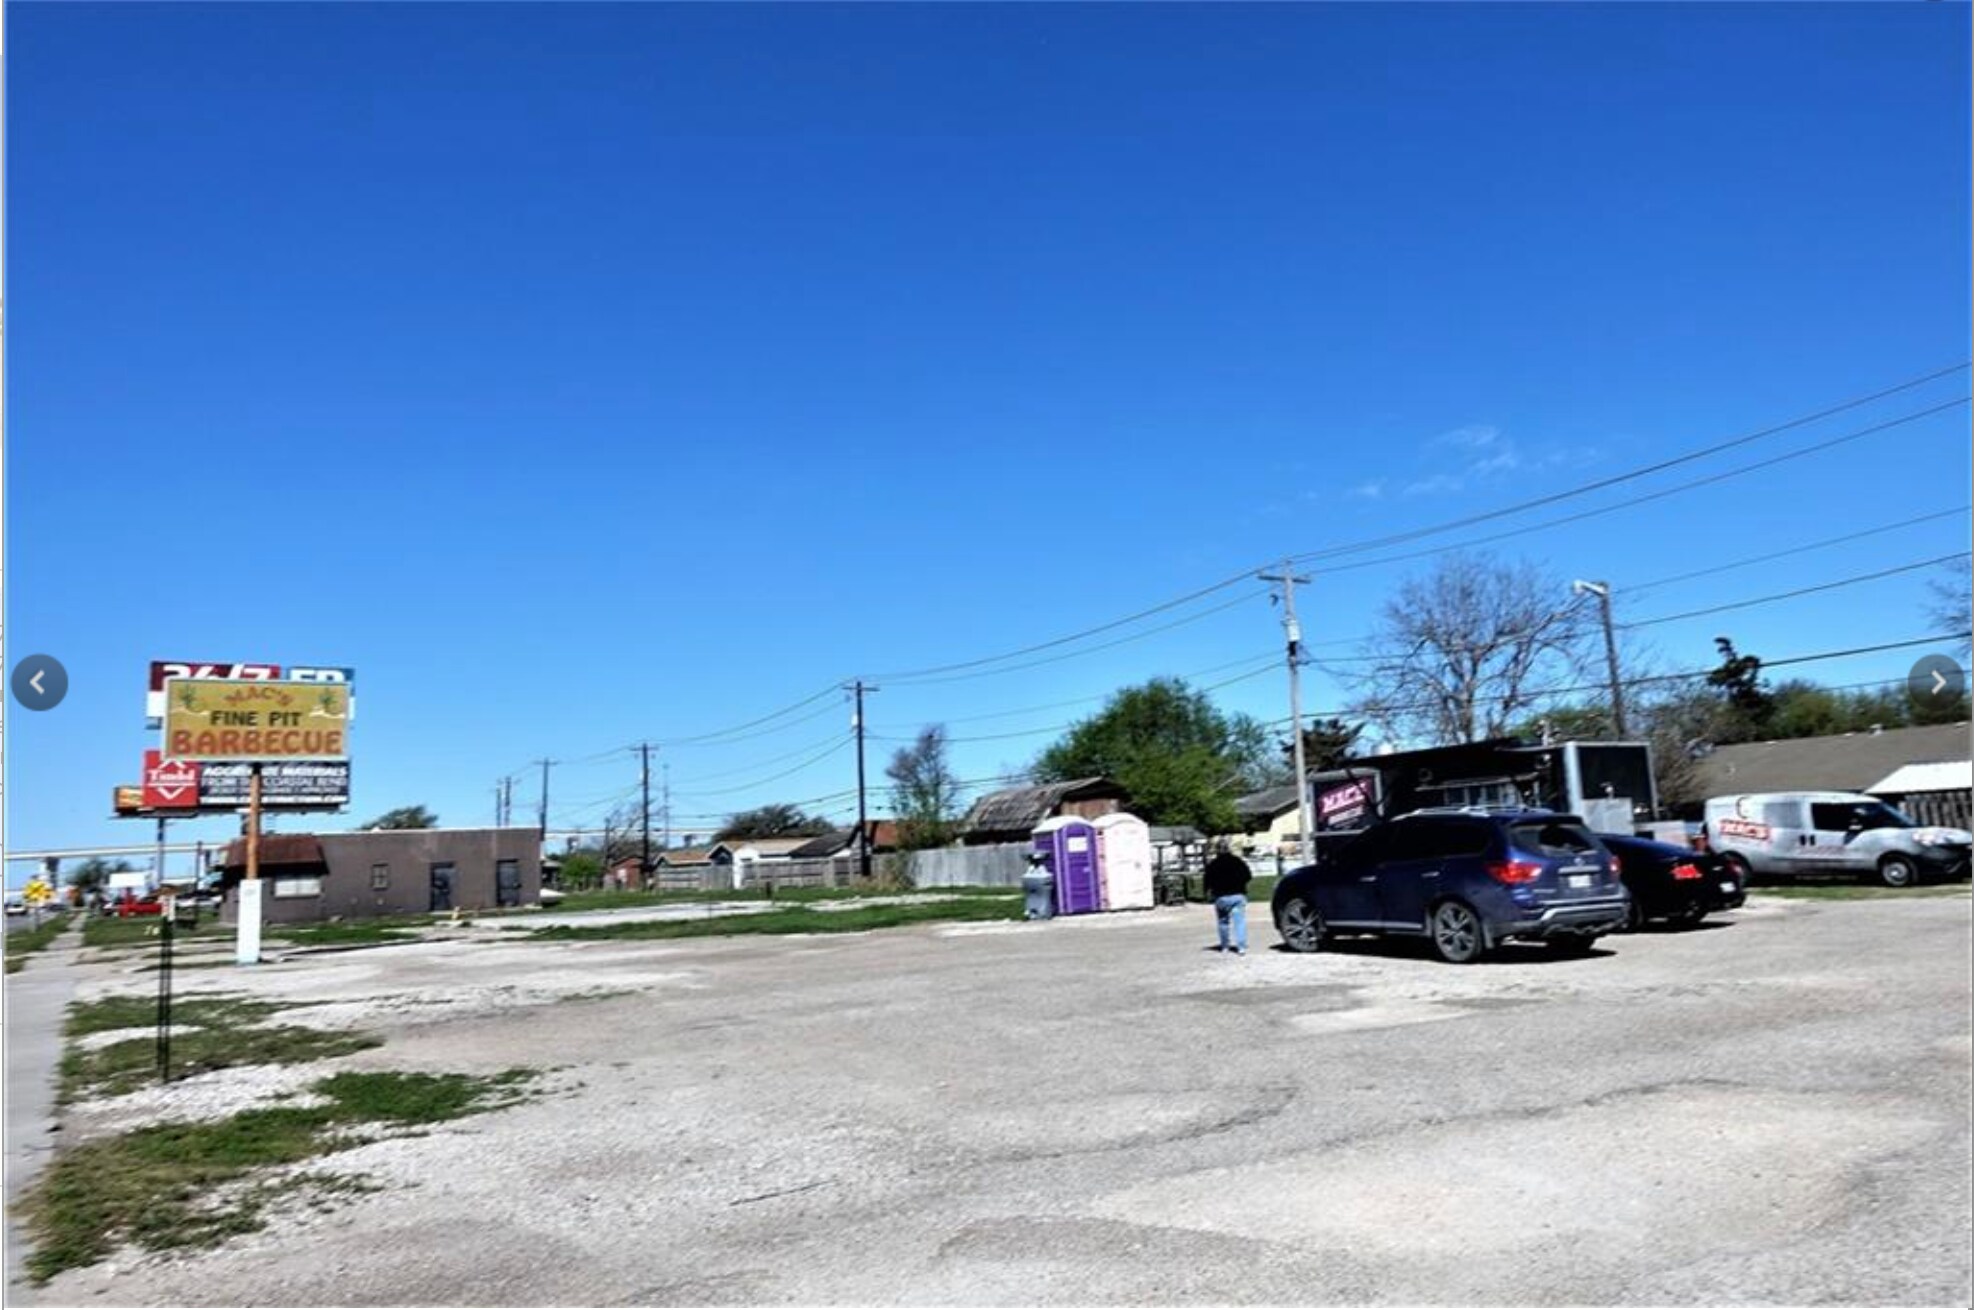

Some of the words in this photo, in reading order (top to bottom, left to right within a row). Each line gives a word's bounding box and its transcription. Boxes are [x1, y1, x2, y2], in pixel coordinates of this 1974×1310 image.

[211, 711, 257, 726] FINE
[269, 711, 302, 726] PIT
[172, 730, 342, 754] BARBECUE
